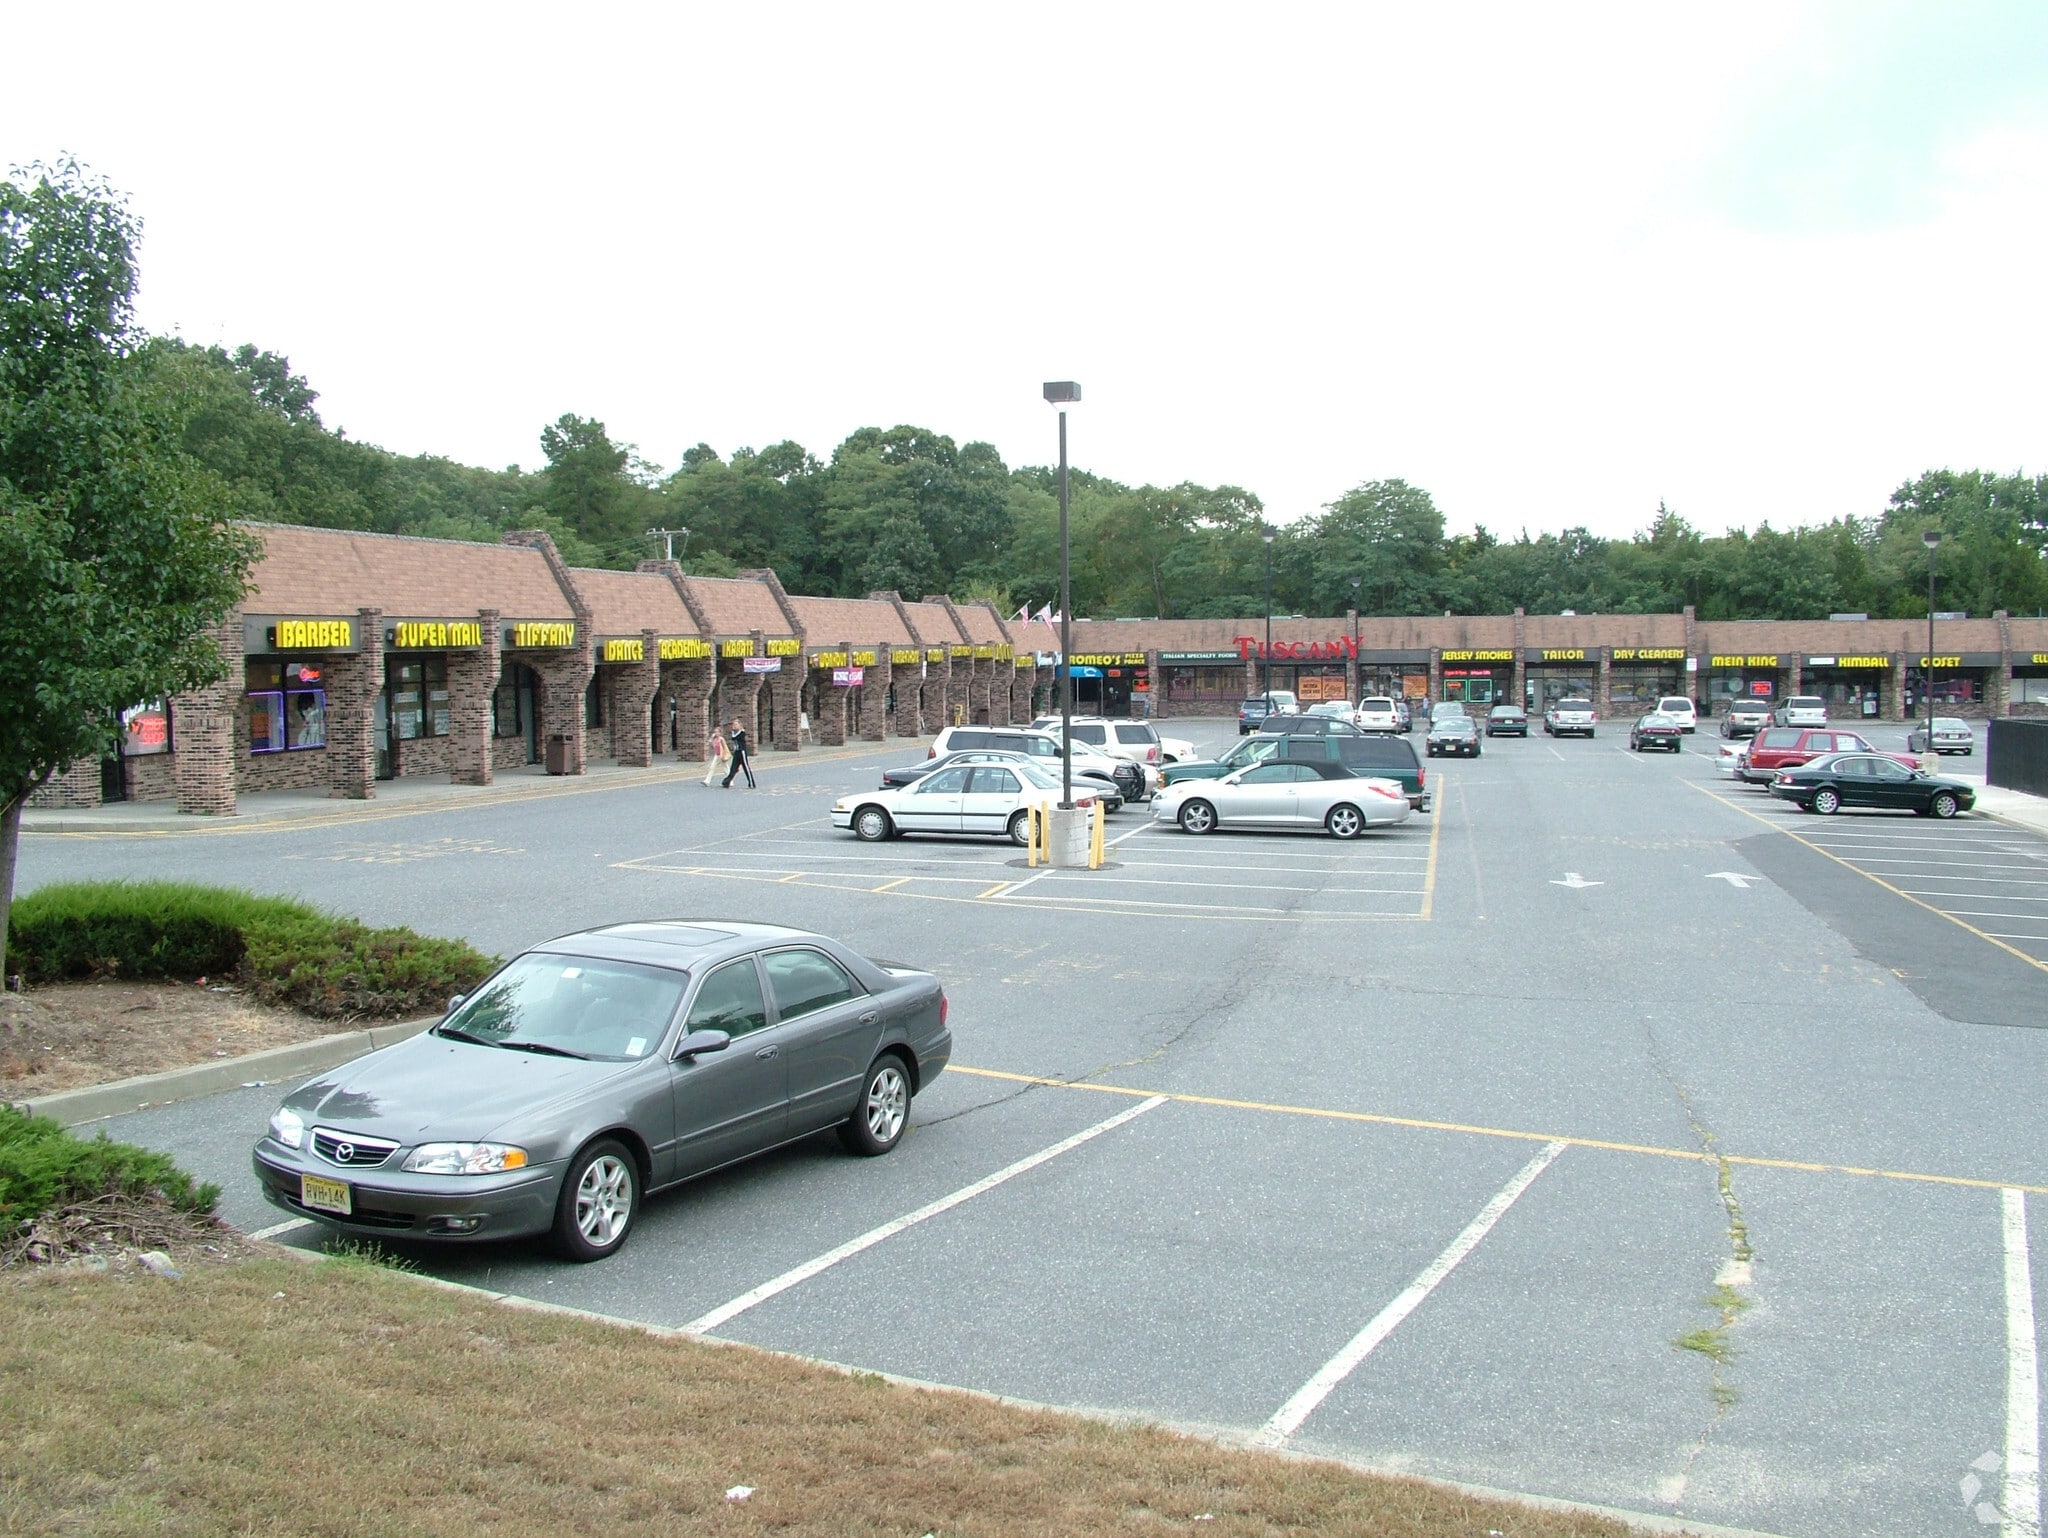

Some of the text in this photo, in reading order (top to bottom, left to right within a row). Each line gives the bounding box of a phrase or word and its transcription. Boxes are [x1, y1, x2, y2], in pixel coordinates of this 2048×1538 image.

[276, 621, 350, 648] BARBER
[396, 622, 447, 647] SUPER
[514, 623, 574, 647] TIFFANY
[604, 640, 644, 661] DANCE
[658, 639, 701, 659] ACADEMY
[722, 639, 800, 658] KARATE ACADEMY
[1232, 635, 1364, 660] TUSCANY
[1441, 651, 1513, 661] JERSEY SMOKES
[1542, 650, 1585, 660] TAILOR
[1613, 649, 1685, 660] DRY CLEANERS
[1068, 655, 1120, 665] ROMEO'S
[1711, 656, 1778, 667] MEIN KING
[1838, 657, 1889, 668] KIMBALL
